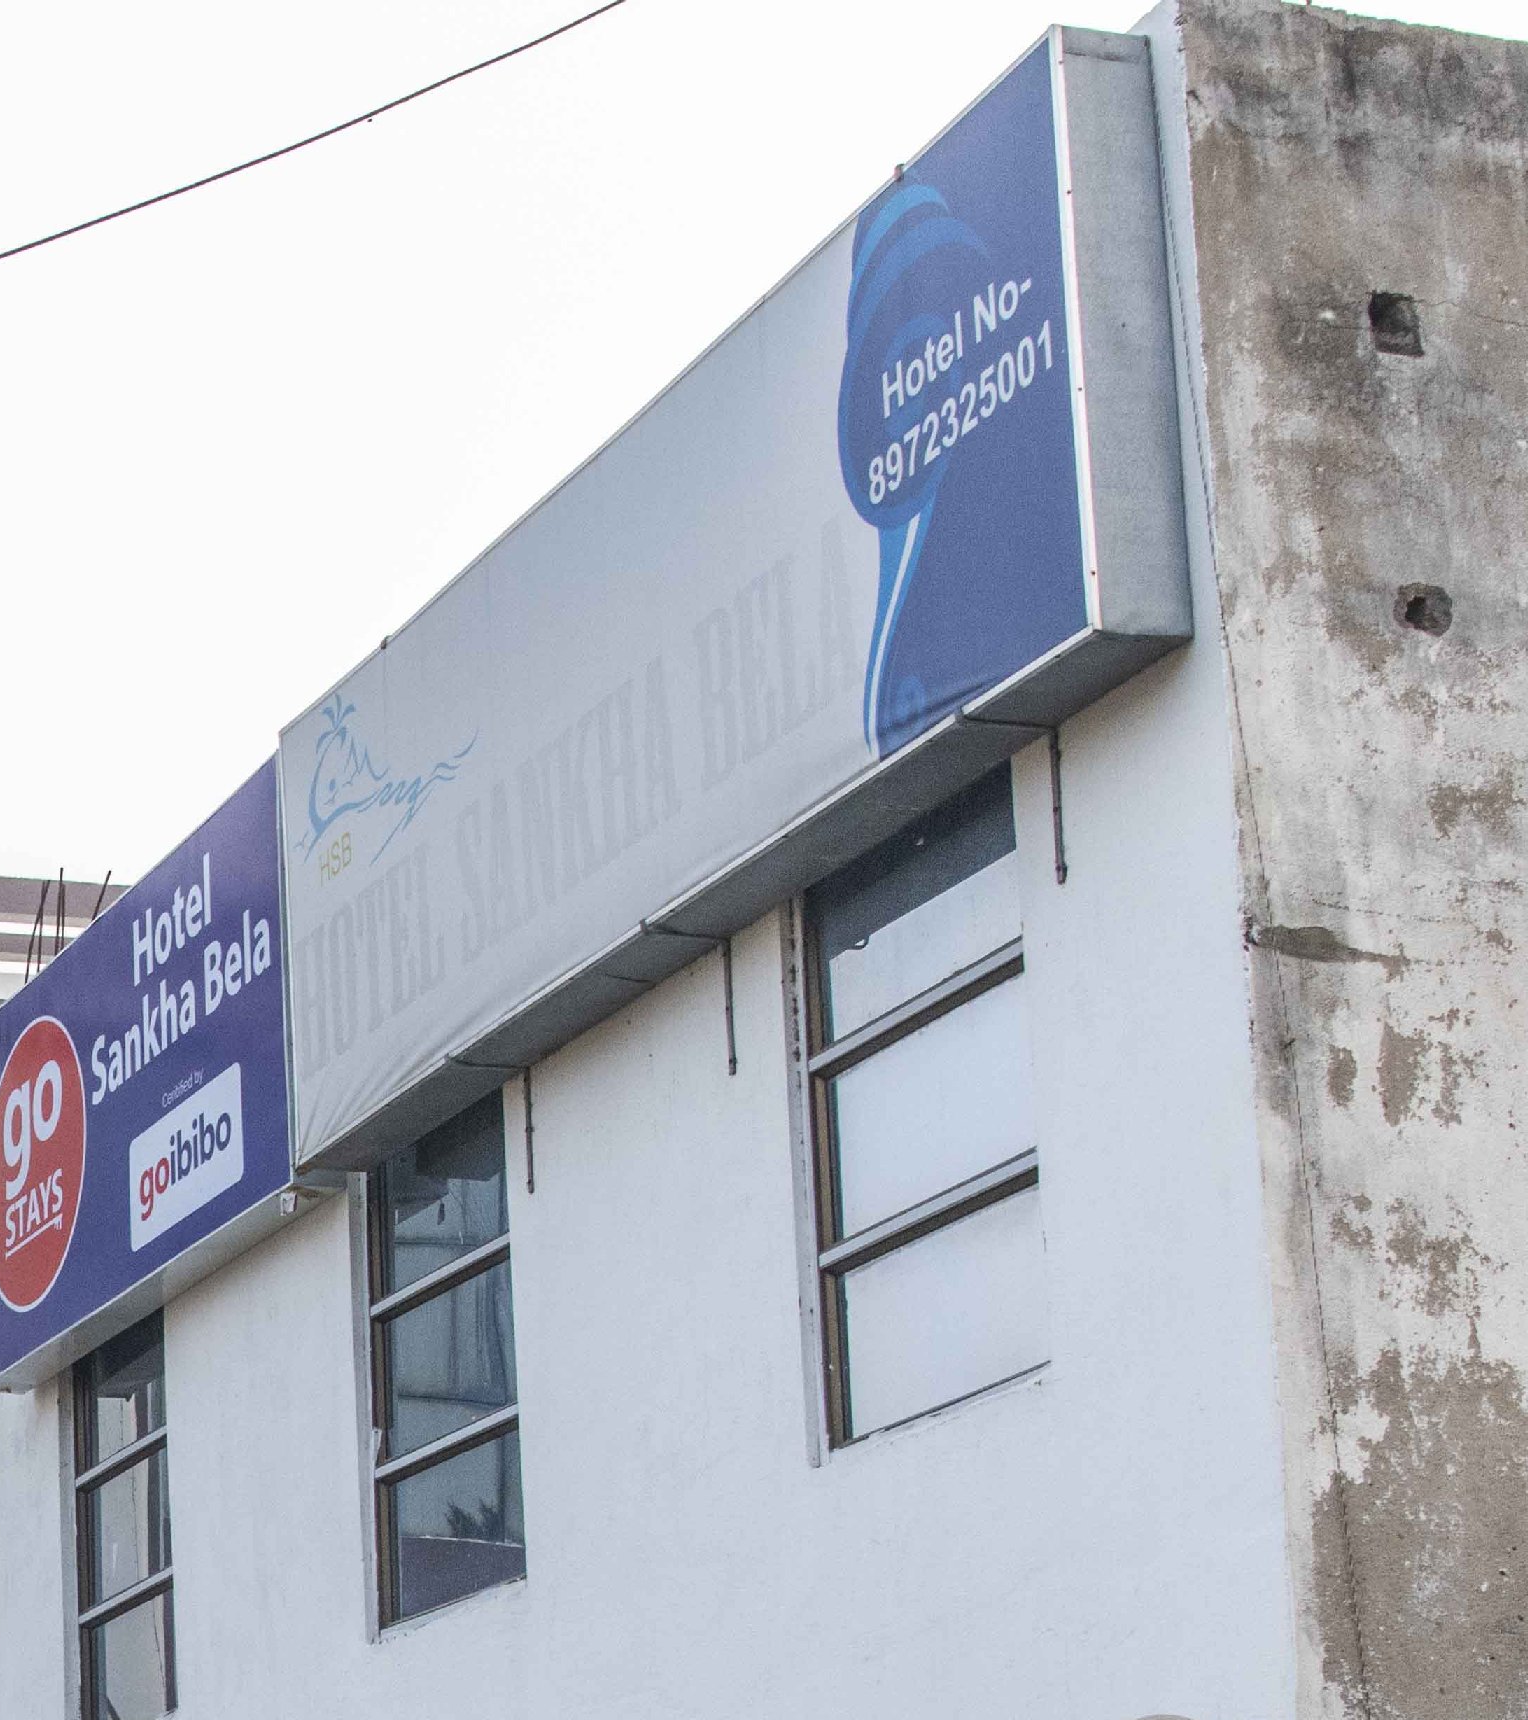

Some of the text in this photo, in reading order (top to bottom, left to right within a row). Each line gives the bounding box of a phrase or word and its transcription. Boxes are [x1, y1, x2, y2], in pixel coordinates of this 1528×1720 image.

[869, 320, 1052, 504] 8972325001
[882, 278, 1032, 418] Hotel No-
[294, 514, 858, 1079] HOTEL SANKHA BELA
[319, 832, 353, 886] HSB
[132, 852, 212, 987] Hotel
[91, 909, 271, 1105] Sankha Bela
[3, 1060, 63, 1200] go
[162, 1067, 204, 1108] Certified by
[5, 1168, 63, 1247] STAYS
[139, 1112, 232, 1221] goibibo
